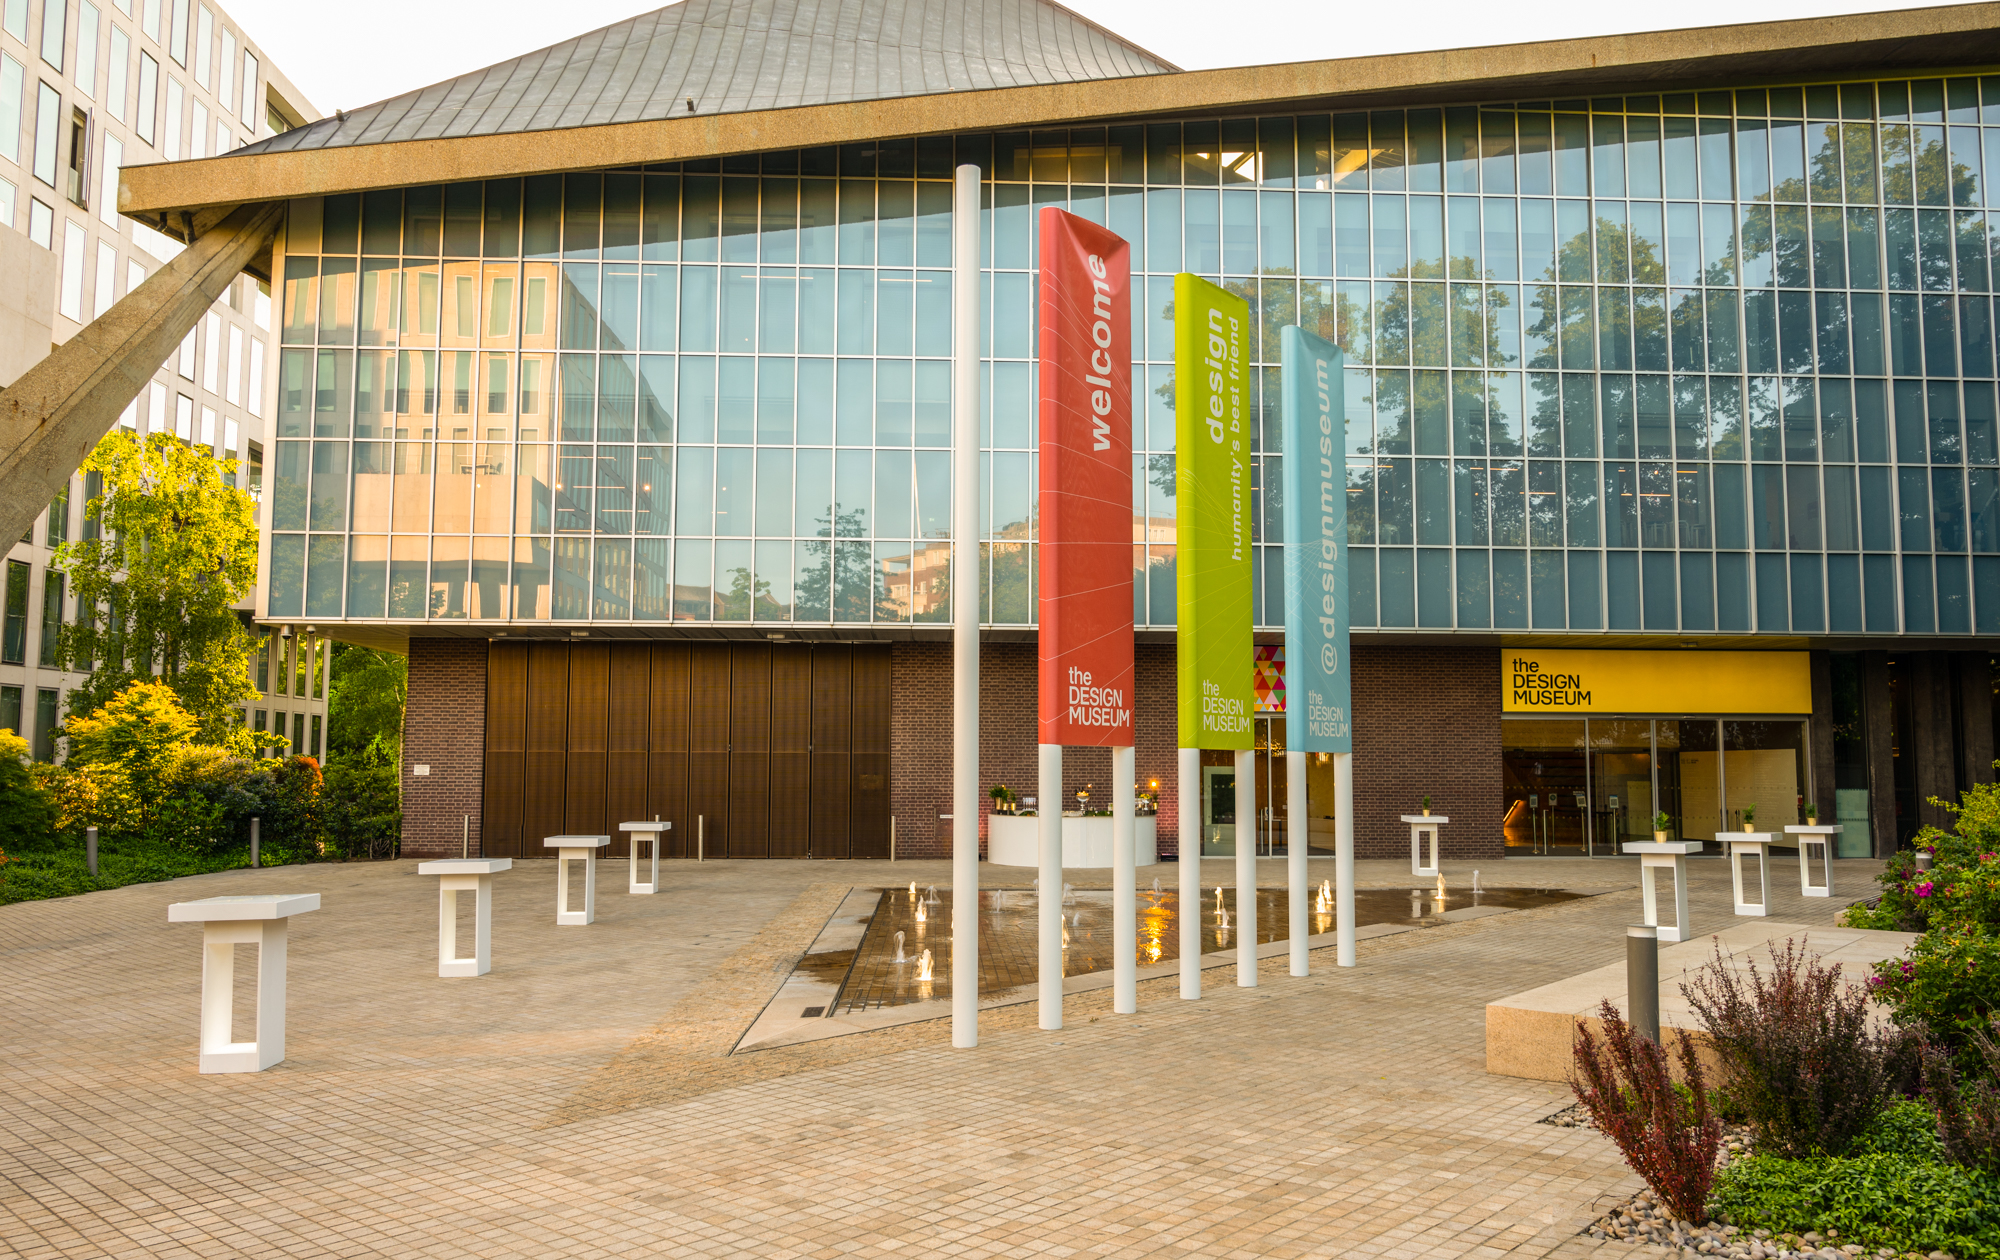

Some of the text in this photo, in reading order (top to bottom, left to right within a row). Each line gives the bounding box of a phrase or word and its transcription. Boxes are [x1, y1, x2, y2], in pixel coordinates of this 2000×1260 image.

[1086, 254, 1112, 451] welcome
[1228, 316, 1240, 381] friend
[1205, 308, 1228, 444] design
[1230, 386, 1240, 433] best
[1315, 358, 1338, 675] @designmuseum
[1512, 657, 1539, 673] the
[1068, 666, 1092, 686] the
[1513, 674, 1580, 689] DESIGN
[1069, 686, 1122, 707] DESIGN
[1203, 679, 1219, 696] the
[1203, 697, 1243, 715] DESIGN
[1308, 690, 1323, 705] the
[1514, 690, 1591, 705] MUSEUM
[1069, 706, 1130, 727] MUSEUM
[1309, 706, 1343, 722] DESIGN
[1203, 715, 1250, 733] MUSEUM
[1309, 721, 1349, 737] MUSEUM
